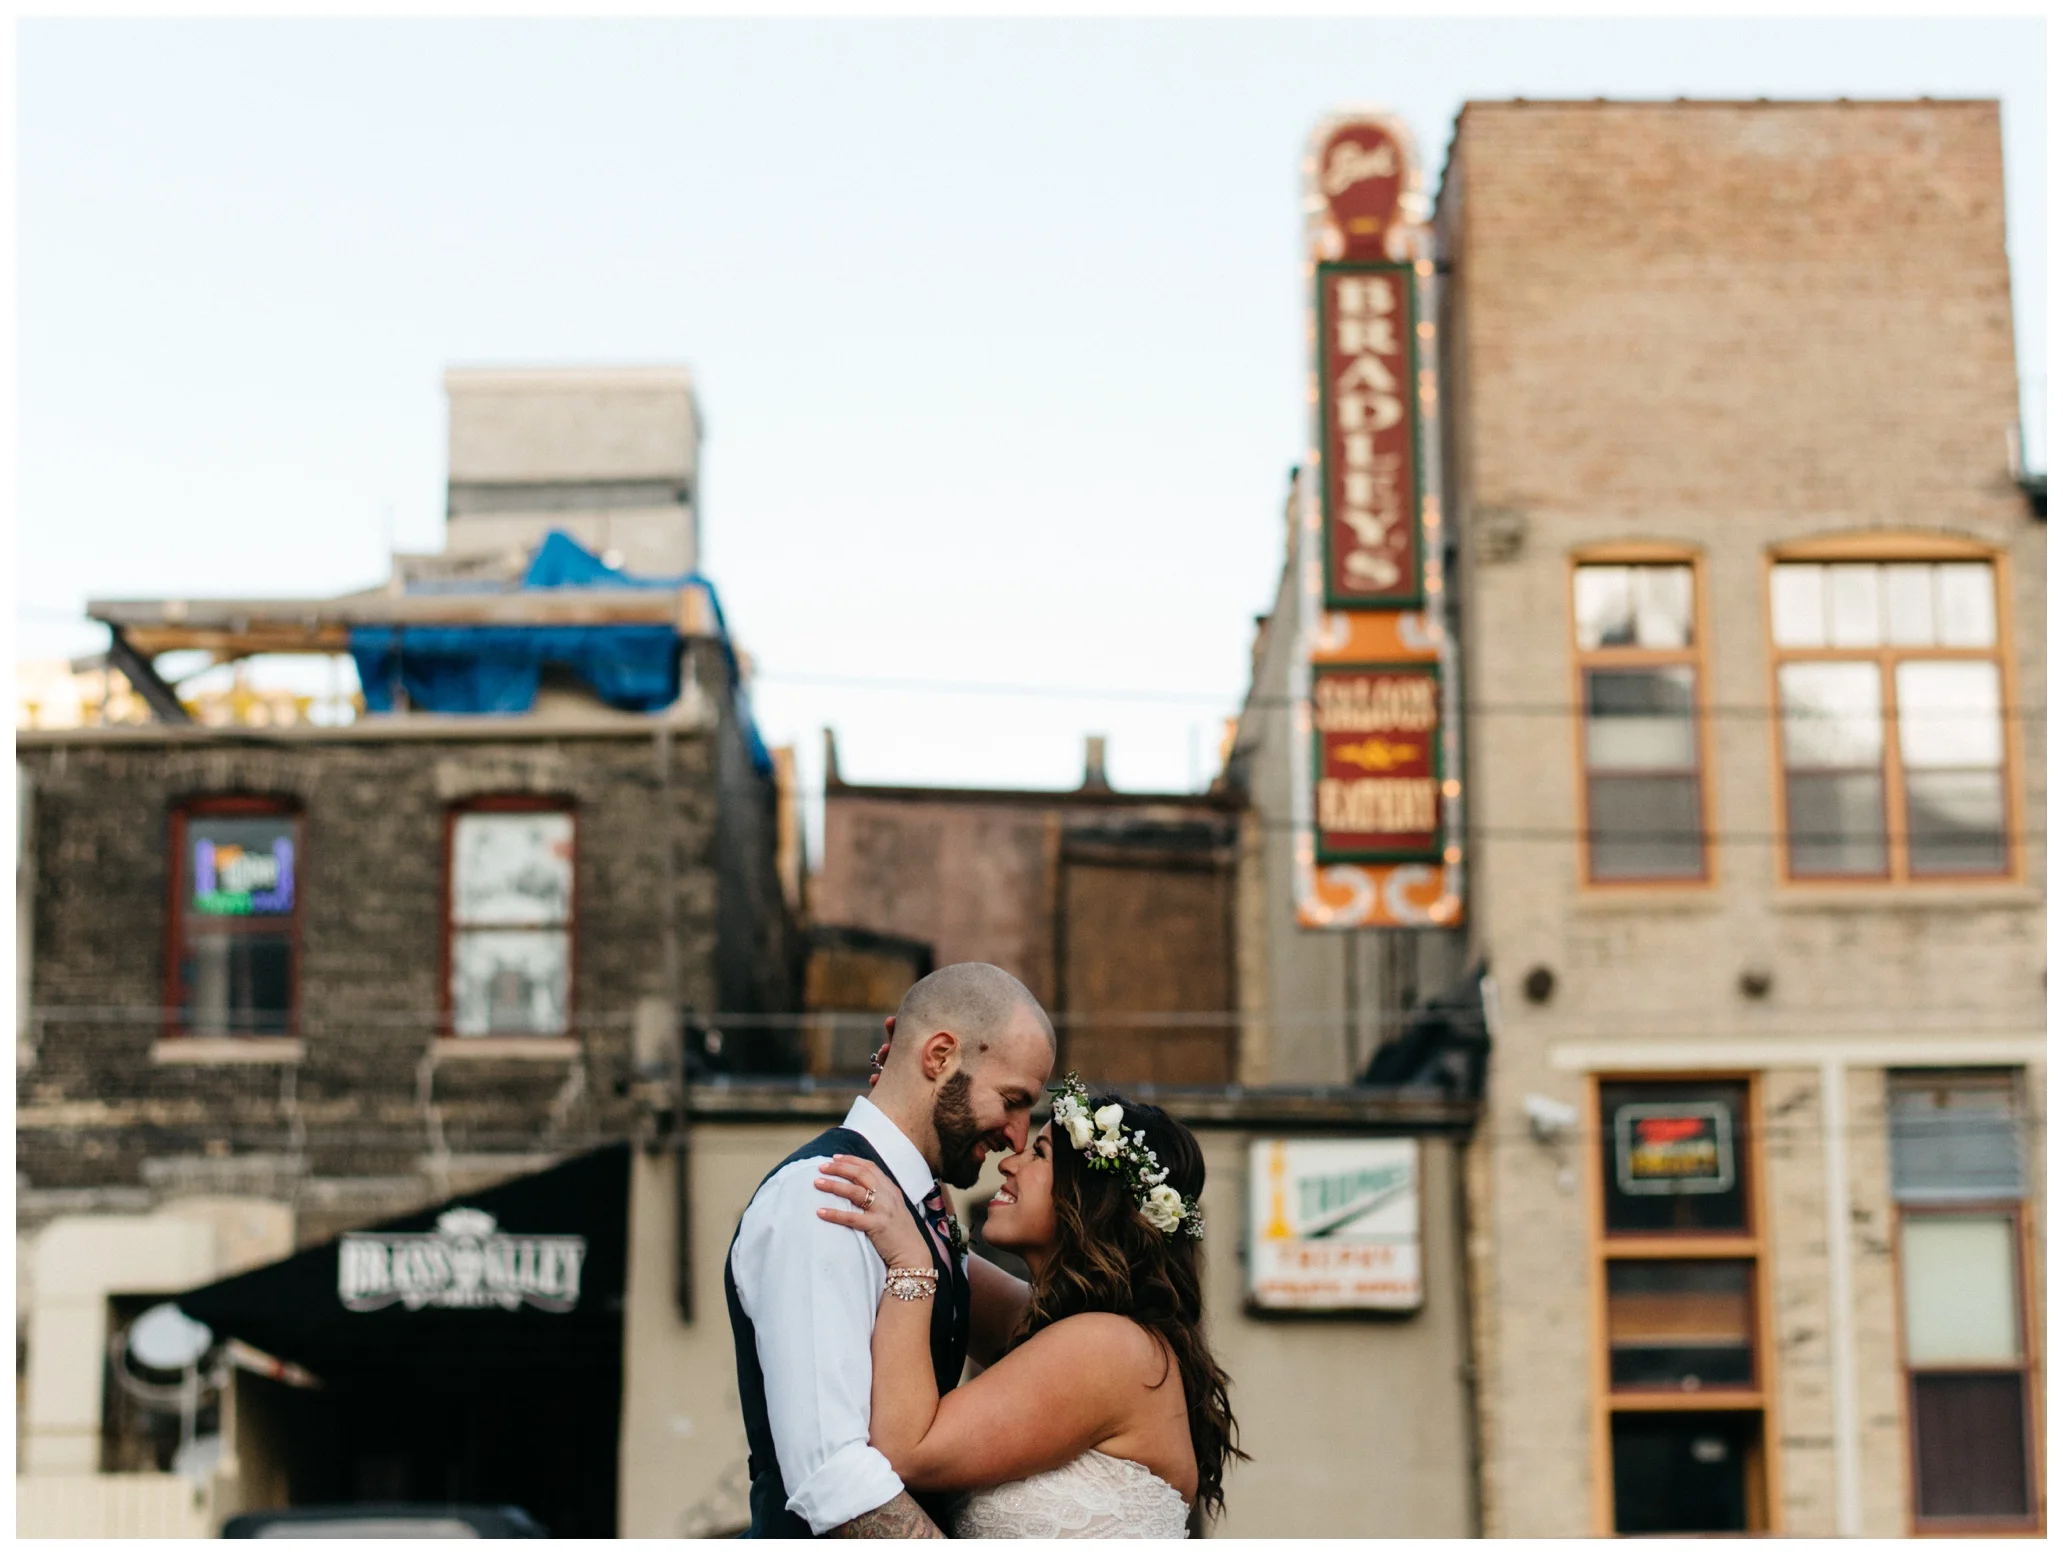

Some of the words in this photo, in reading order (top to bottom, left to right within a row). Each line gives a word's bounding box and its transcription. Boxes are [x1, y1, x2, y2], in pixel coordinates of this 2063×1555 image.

[1317, 677, 1437, 730] SALOON
[1319, 779, 1437, 831] EATERY
[338, 1239, 450, 1297] BRASS
[481, 1239, 585, 1297] ALLEY
